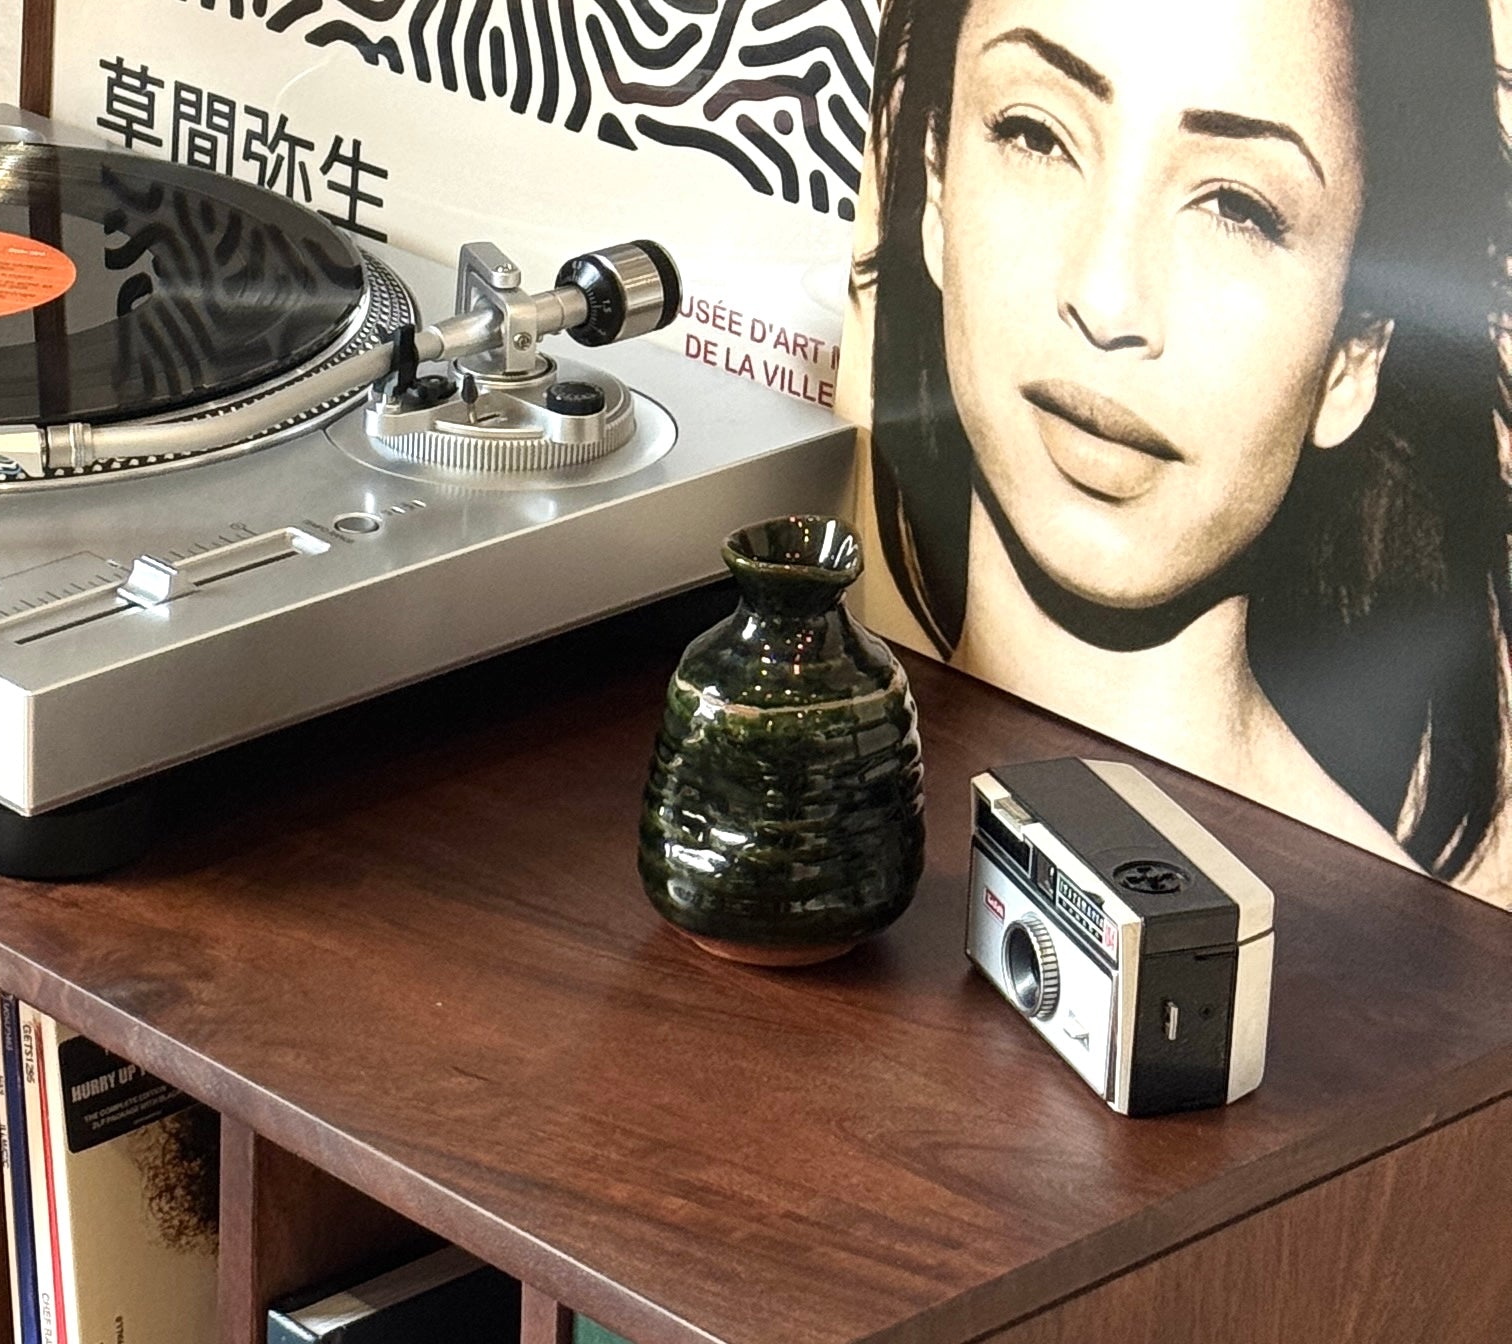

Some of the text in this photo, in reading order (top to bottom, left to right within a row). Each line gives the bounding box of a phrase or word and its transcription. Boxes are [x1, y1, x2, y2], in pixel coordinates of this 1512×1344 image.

[96, 56, 388, 244] 草間弥生
[680, 295, 743, 337] USÉE
[750, 318, 825, 364] D'ART
[685, 334, 834, 407] DE LA VILLE
[71, 1071, 116, 1103] HURRY
[118, 1064, 136, 1085] UP
[41, 1294, 53, 1325] CHEF
